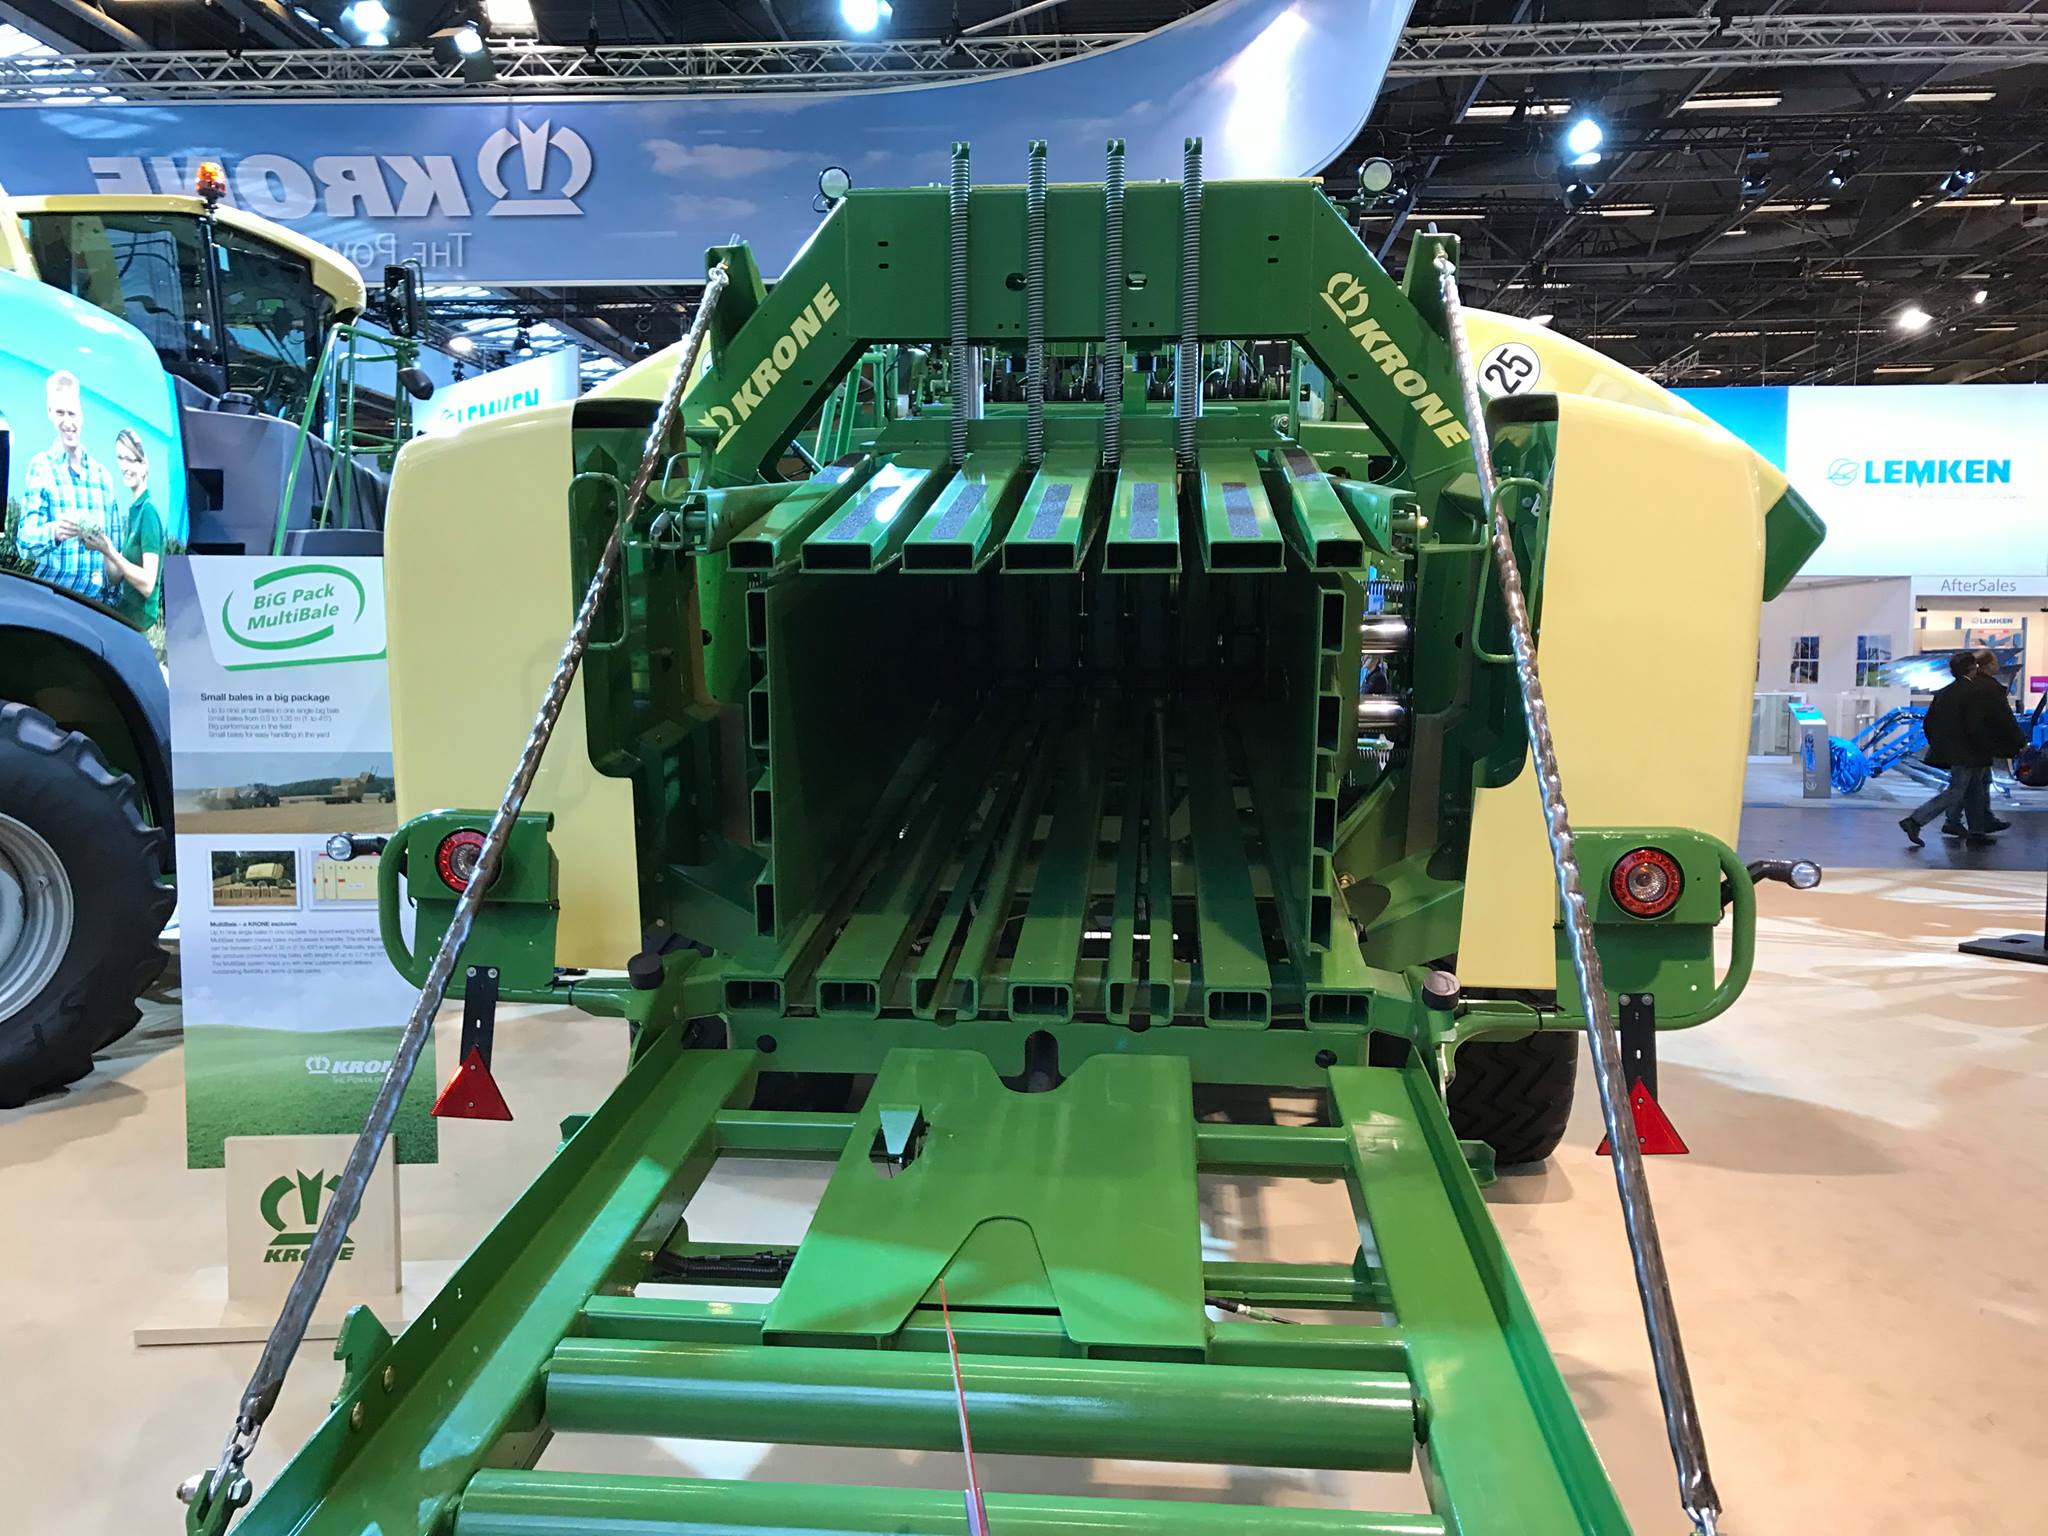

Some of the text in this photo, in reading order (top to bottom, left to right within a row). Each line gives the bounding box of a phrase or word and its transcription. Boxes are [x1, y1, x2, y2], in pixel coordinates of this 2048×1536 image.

[732, 282, 840, 421] KRONE
[1349, 318, 1471, 448] KRONE
[1485, 348, 1533, 394] 25
[1865, 459, 2011, 488] LEMKEN
[253, 583, 335, 610] BiG Pack
[1940, 577, 2016, 593] AfterSales
[247, 603, 339, 630] MultiBale
[200, 693, 226, 702] Small
[228, 693, 253, 702] bales
[255, 693, 264, 702] in
[274, 693, 289, 703] big
[291, 693, 330, 703] package
[263, 1247, 355, 1263] KRE
